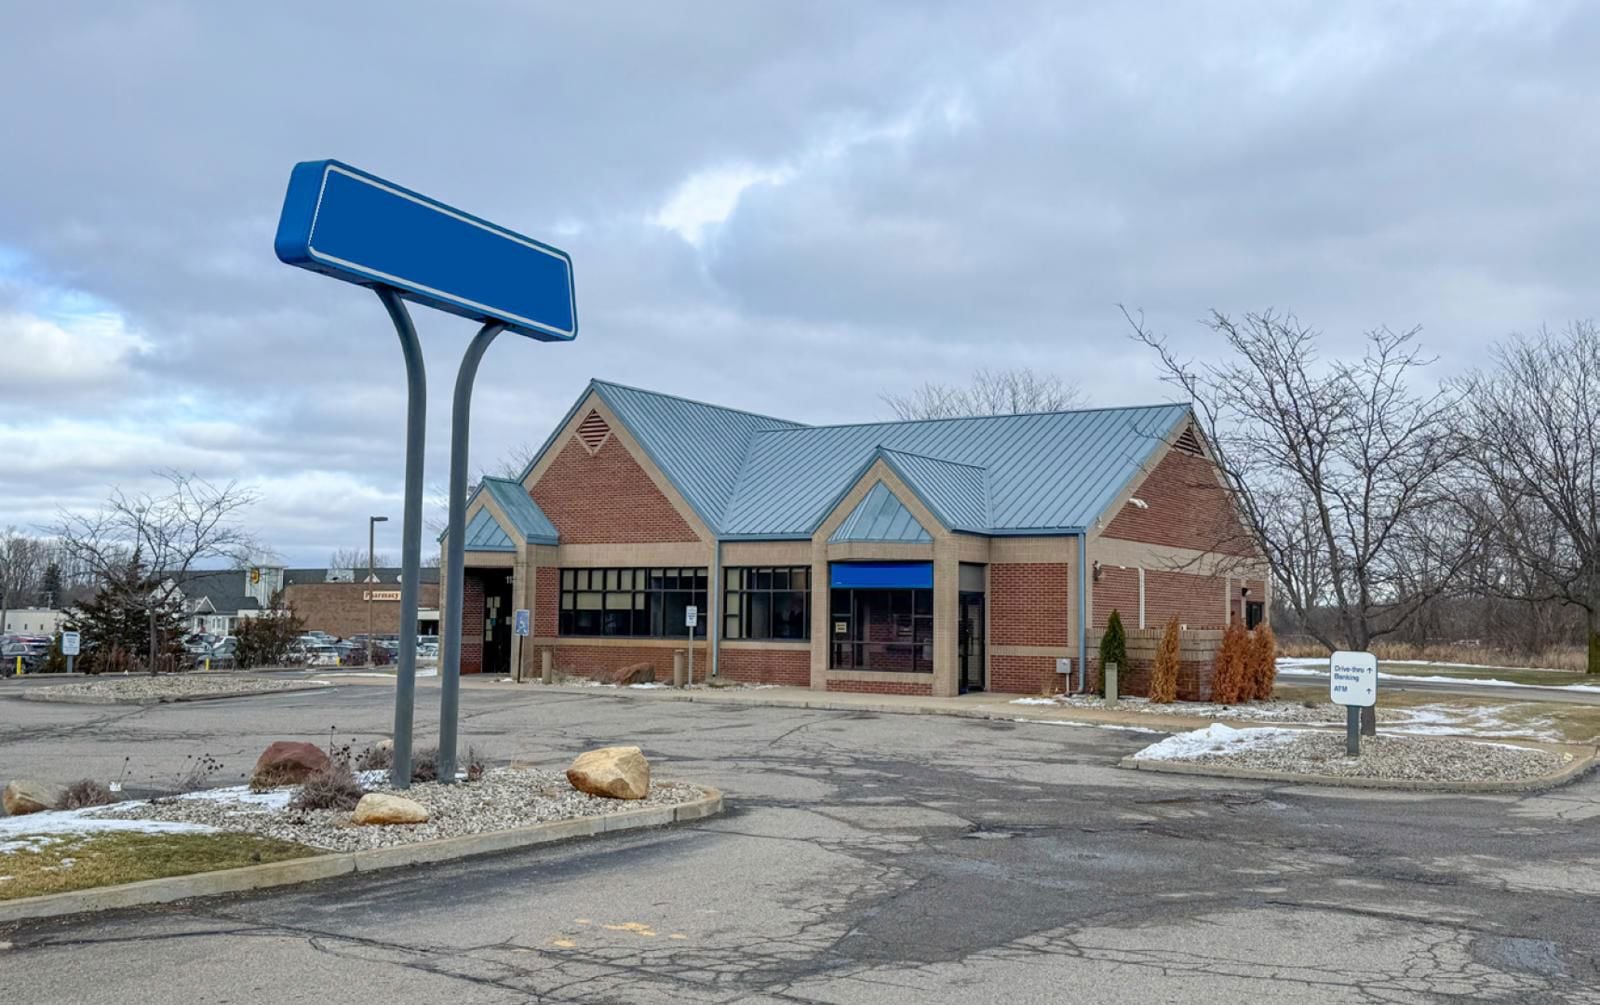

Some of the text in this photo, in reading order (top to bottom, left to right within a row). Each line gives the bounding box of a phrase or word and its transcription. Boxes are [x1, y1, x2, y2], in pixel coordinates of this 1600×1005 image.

[365, 592, 399, 600] Parmacy
[1335, 665, 1365, 673] Drive-thru
[1334, 673, 1359, 682] Banking
